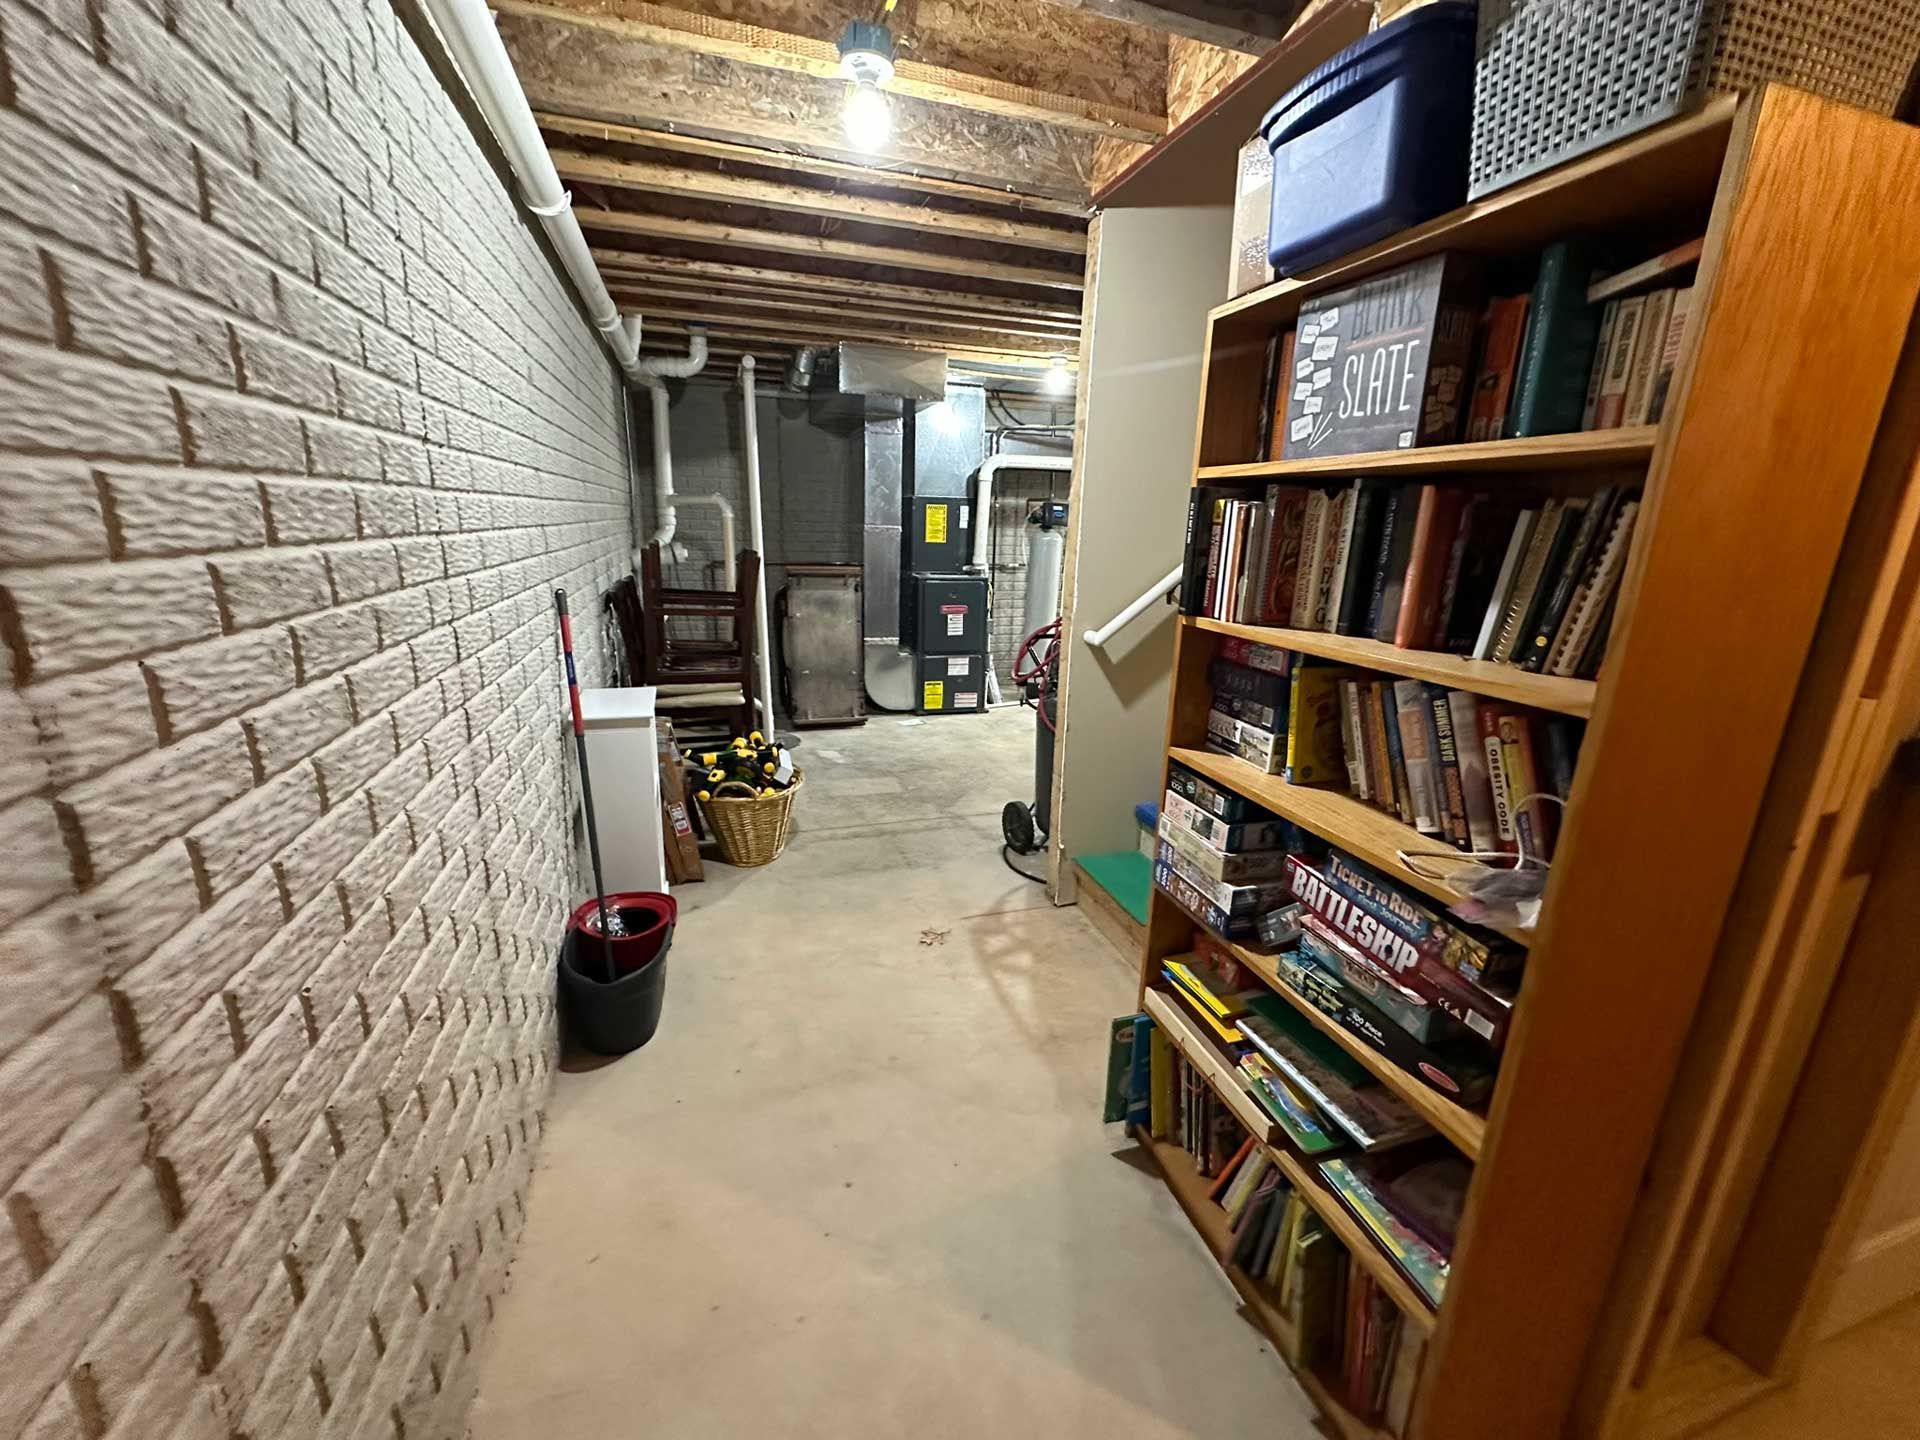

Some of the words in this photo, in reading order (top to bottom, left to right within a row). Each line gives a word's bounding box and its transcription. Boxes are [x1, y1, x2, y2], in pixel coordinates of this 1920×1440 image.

[1351, 272, 1425, 340] BLANK
[1339, 339, 1421, 419] SLATE
[1433, 699, 1452, 736] SUMMER
[1439, 737, 1456, 762] DARK
[1490, 748, 1504, 799] OBESITY
[1498, 802, 1510, 834] CODE
[1291, 865, 1419, 975] BATTLESHIP
[1330, 855, 1376, 897] TICKET
[1375, 888, 1388, 905] TO
[1388, 892, 1425, 929] RIDE
